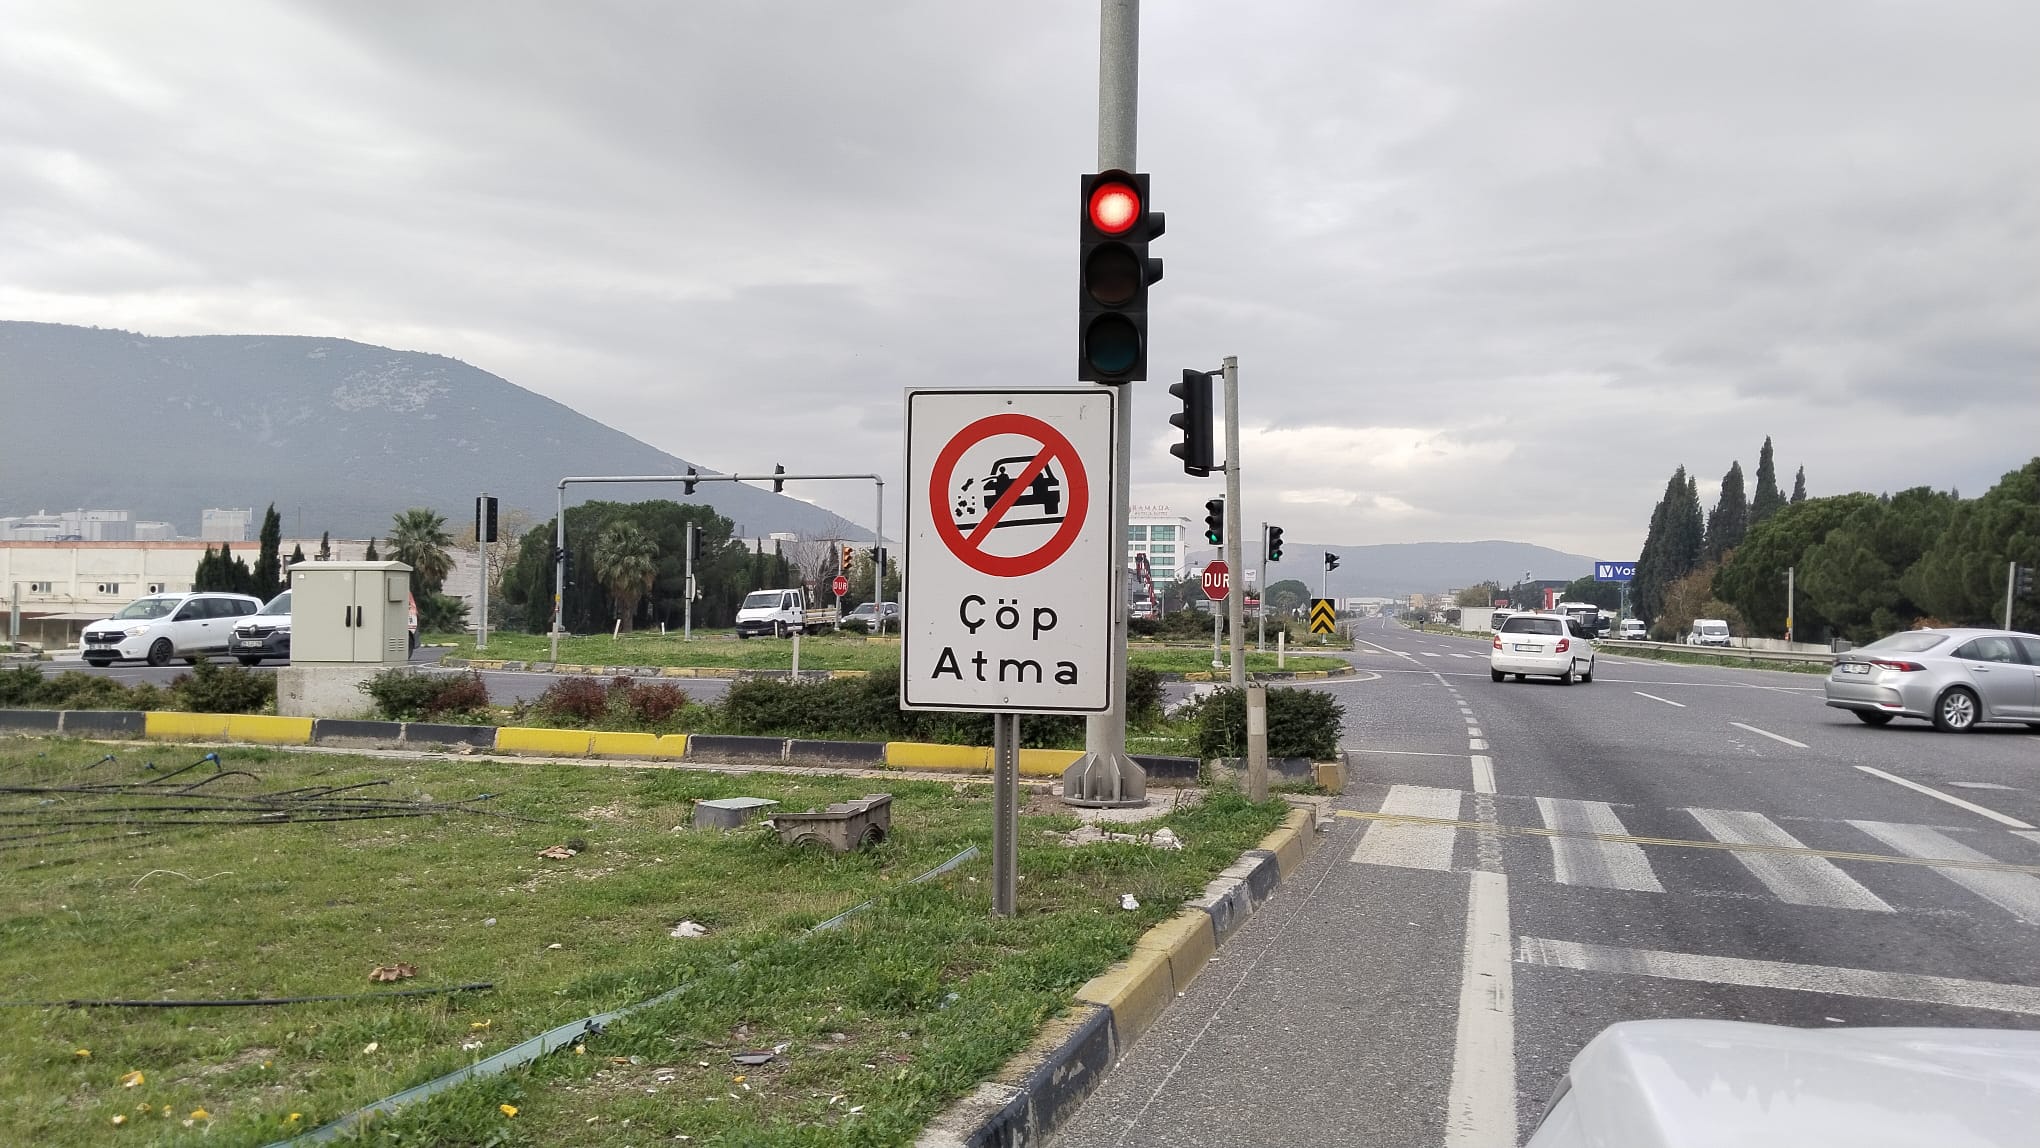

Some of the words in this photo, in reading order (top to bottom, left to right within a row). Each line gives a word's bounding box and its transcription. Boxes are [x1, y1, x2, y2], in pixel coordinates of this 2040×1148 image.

[833, 581, 847, 590] DUR
[1204, 572, 1229, 588] DUR
[959, 594, 1058, 640] Çöp
[931, 647, 1078, 685] Atma
